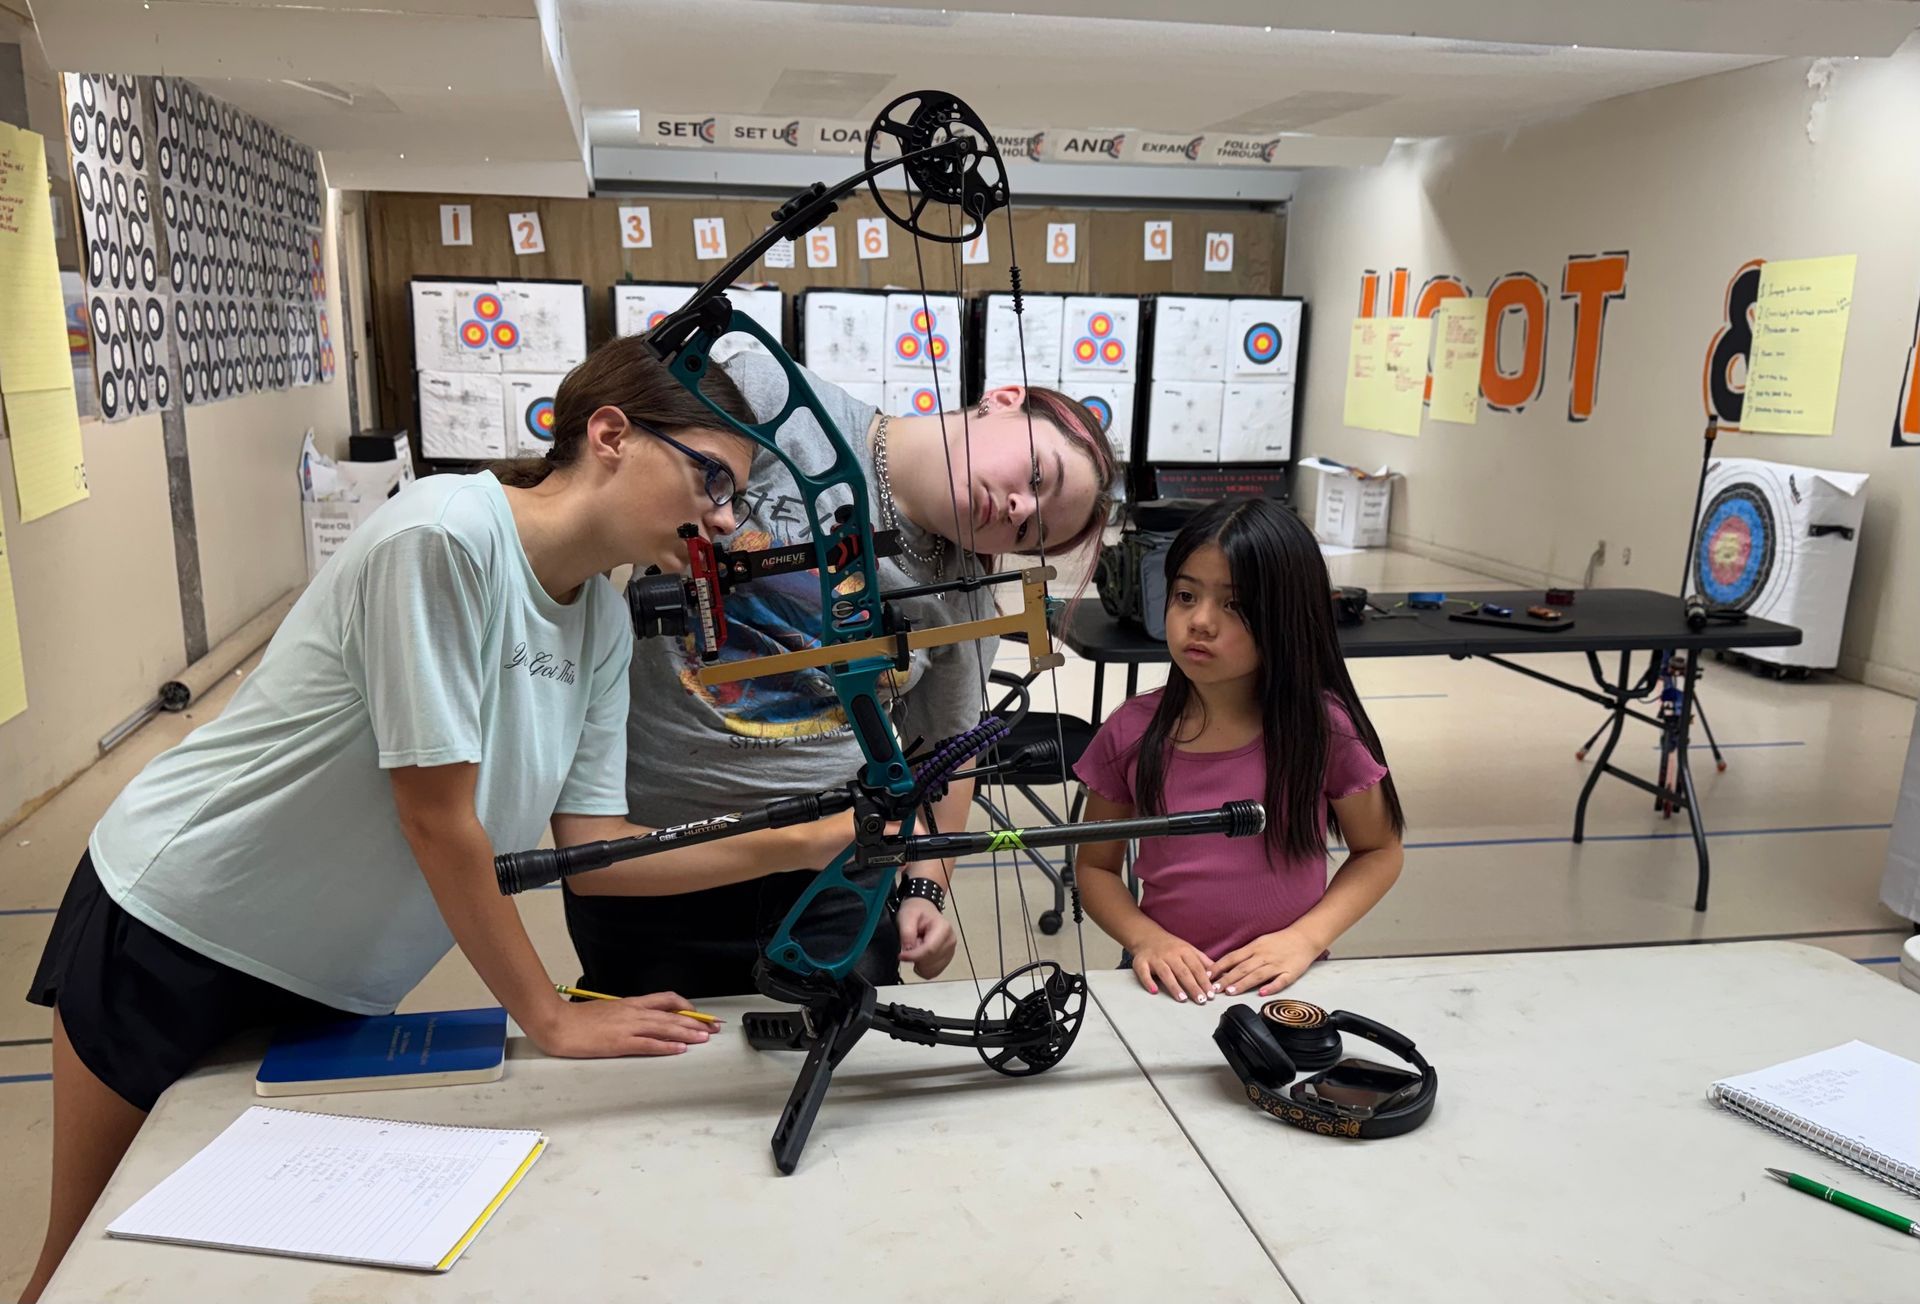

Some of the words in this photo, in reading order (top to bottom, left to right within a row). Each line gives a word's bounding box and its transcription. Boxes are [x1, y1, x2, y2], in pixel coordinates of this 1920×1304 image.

[657, 121, 702, 137] SET
[734, 126, 767, 139] SET
[1064, 138, 1115, 153] AND
[1217, 147, 1270, 159] THROUG
[452, 212, 461, 241] 1
[517, 220, 538, 250] 2
[626, 214, 645, 244] 3
[699, 225, 720, 254] 4
[811, 234, 831, 263] 5
[864, 226, 882, 254] 6
[1052, 231, 1070, 258] 8
[1149, 228, 1168, 256] 9
[1209, 239, 1230, 263] 10
[314, 522, 335, 530] Place
[336, 521, 352, 530] Old
[320, 549, 336, 557] Her
[762, 552, 806, 568] ACHIEVE
[529, 651, 559, 678] Got
[556, 658, 576, 686] This
[683, 822, 728, 837] HUNTING
